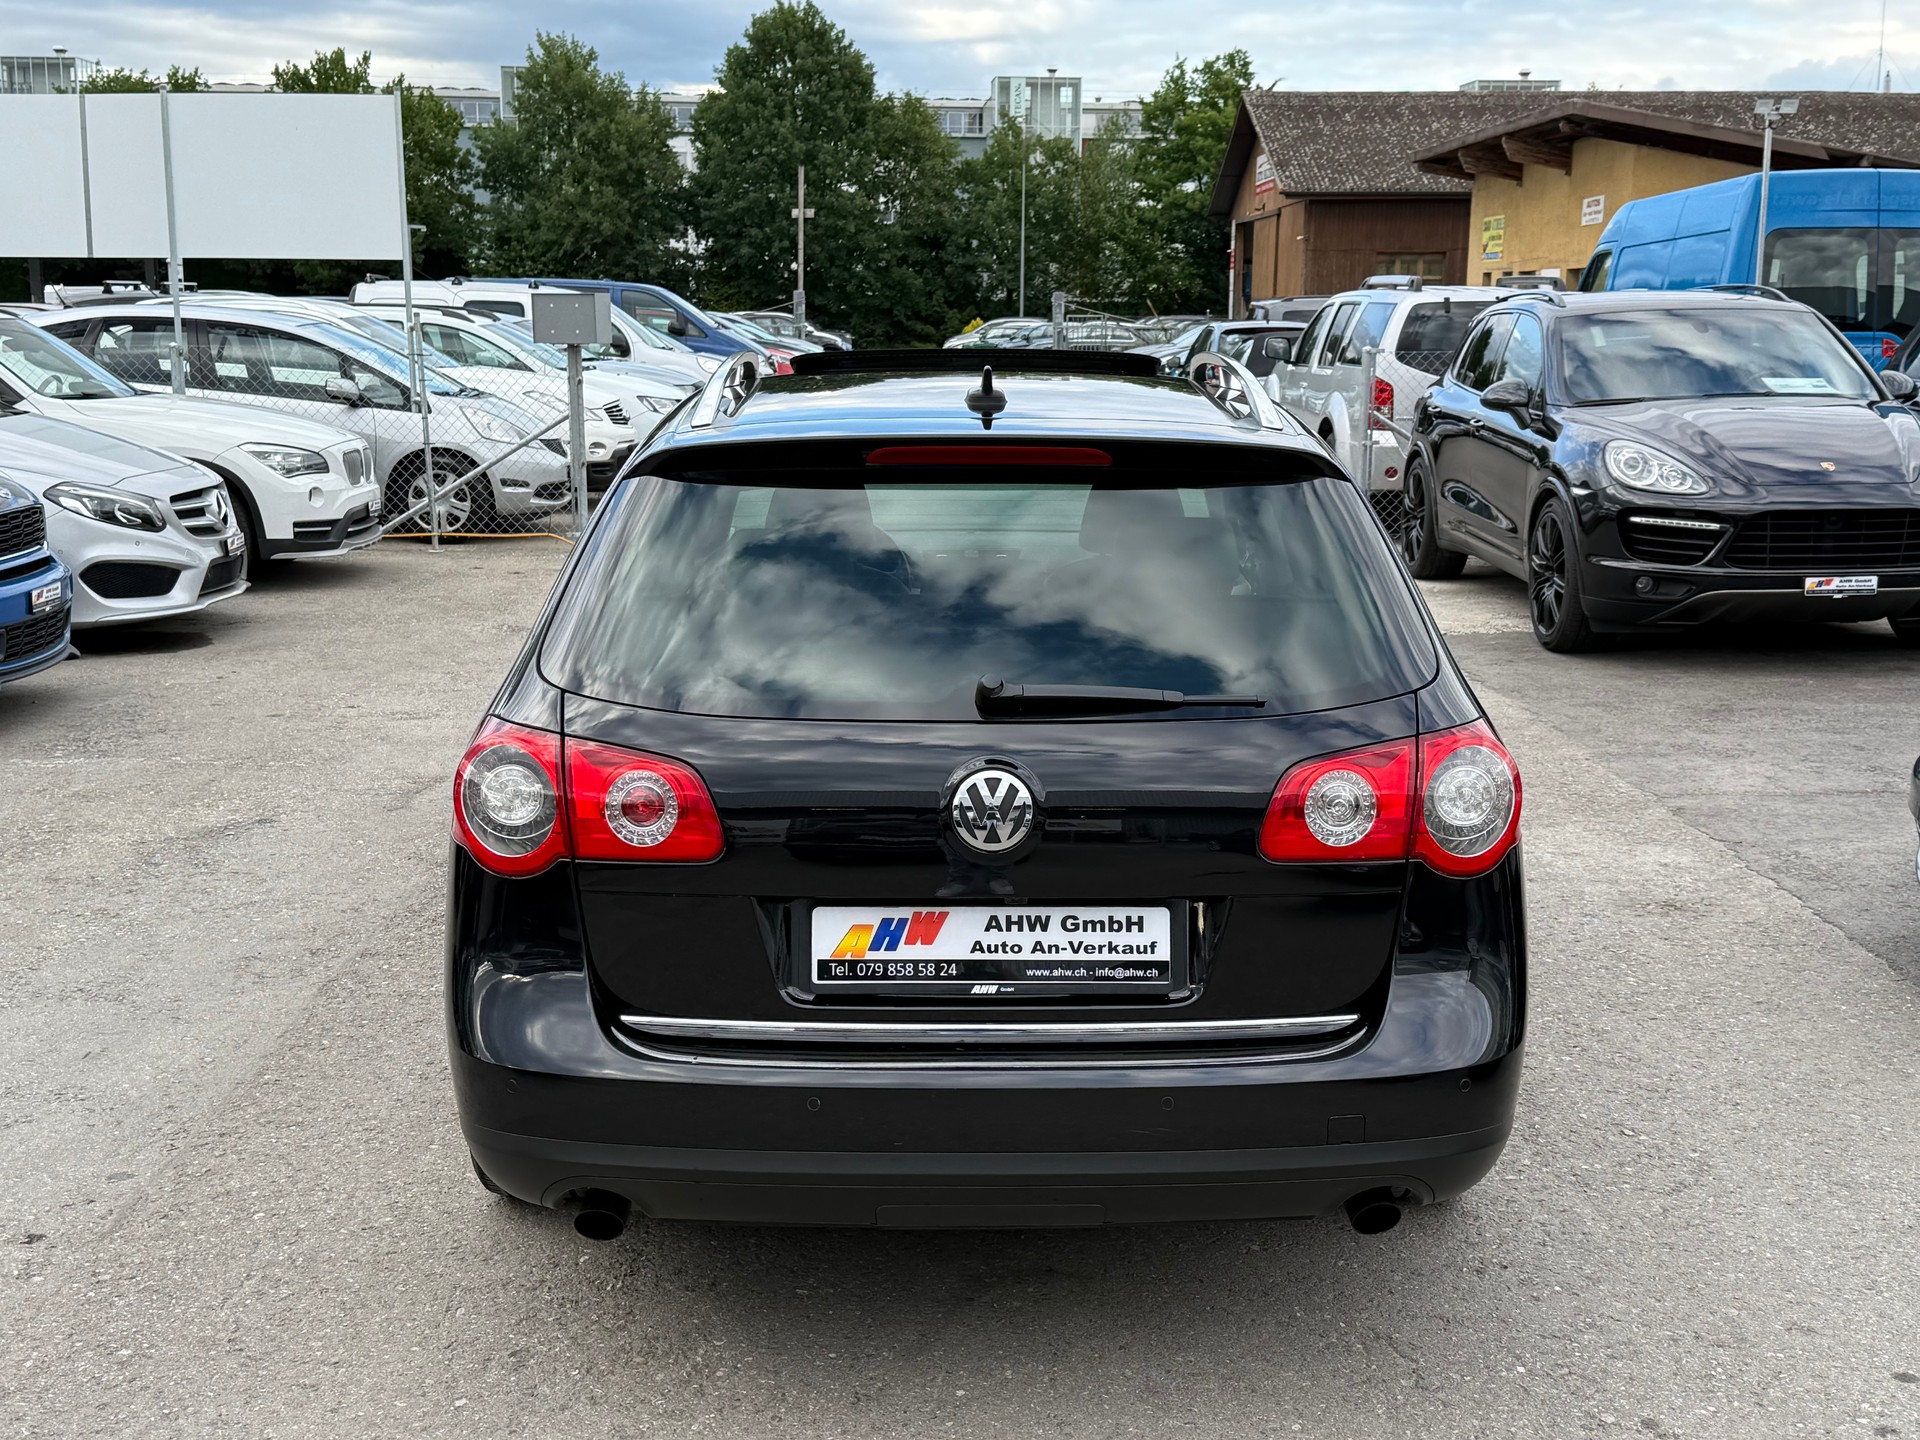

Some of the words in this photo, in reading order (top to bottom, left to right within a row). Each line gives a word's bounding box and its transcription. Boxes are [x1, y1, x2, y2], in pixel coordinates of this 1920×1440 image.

[983, 914, 1051, 933] AHW
[1060, 914, 1144, 933] GmbH
[829, 911, 950, 959] AHW
[969, 940, 1023, 955] Auto
[1030, 940, 1158, 955] An-Verkauf
[829, 962, 853, 976] Tel.
[856, 962, 884, 976] 079
[887, 962, 914, 976] 858
[918, 962, 936, 976] 58
[939, 962, 957, 976] 24
[1026, 967, 1087, 977] www.ahw.ch
[1095, 967, 1159, 979] info@ahw.ch
[971, 984, 999, 994] AHW
